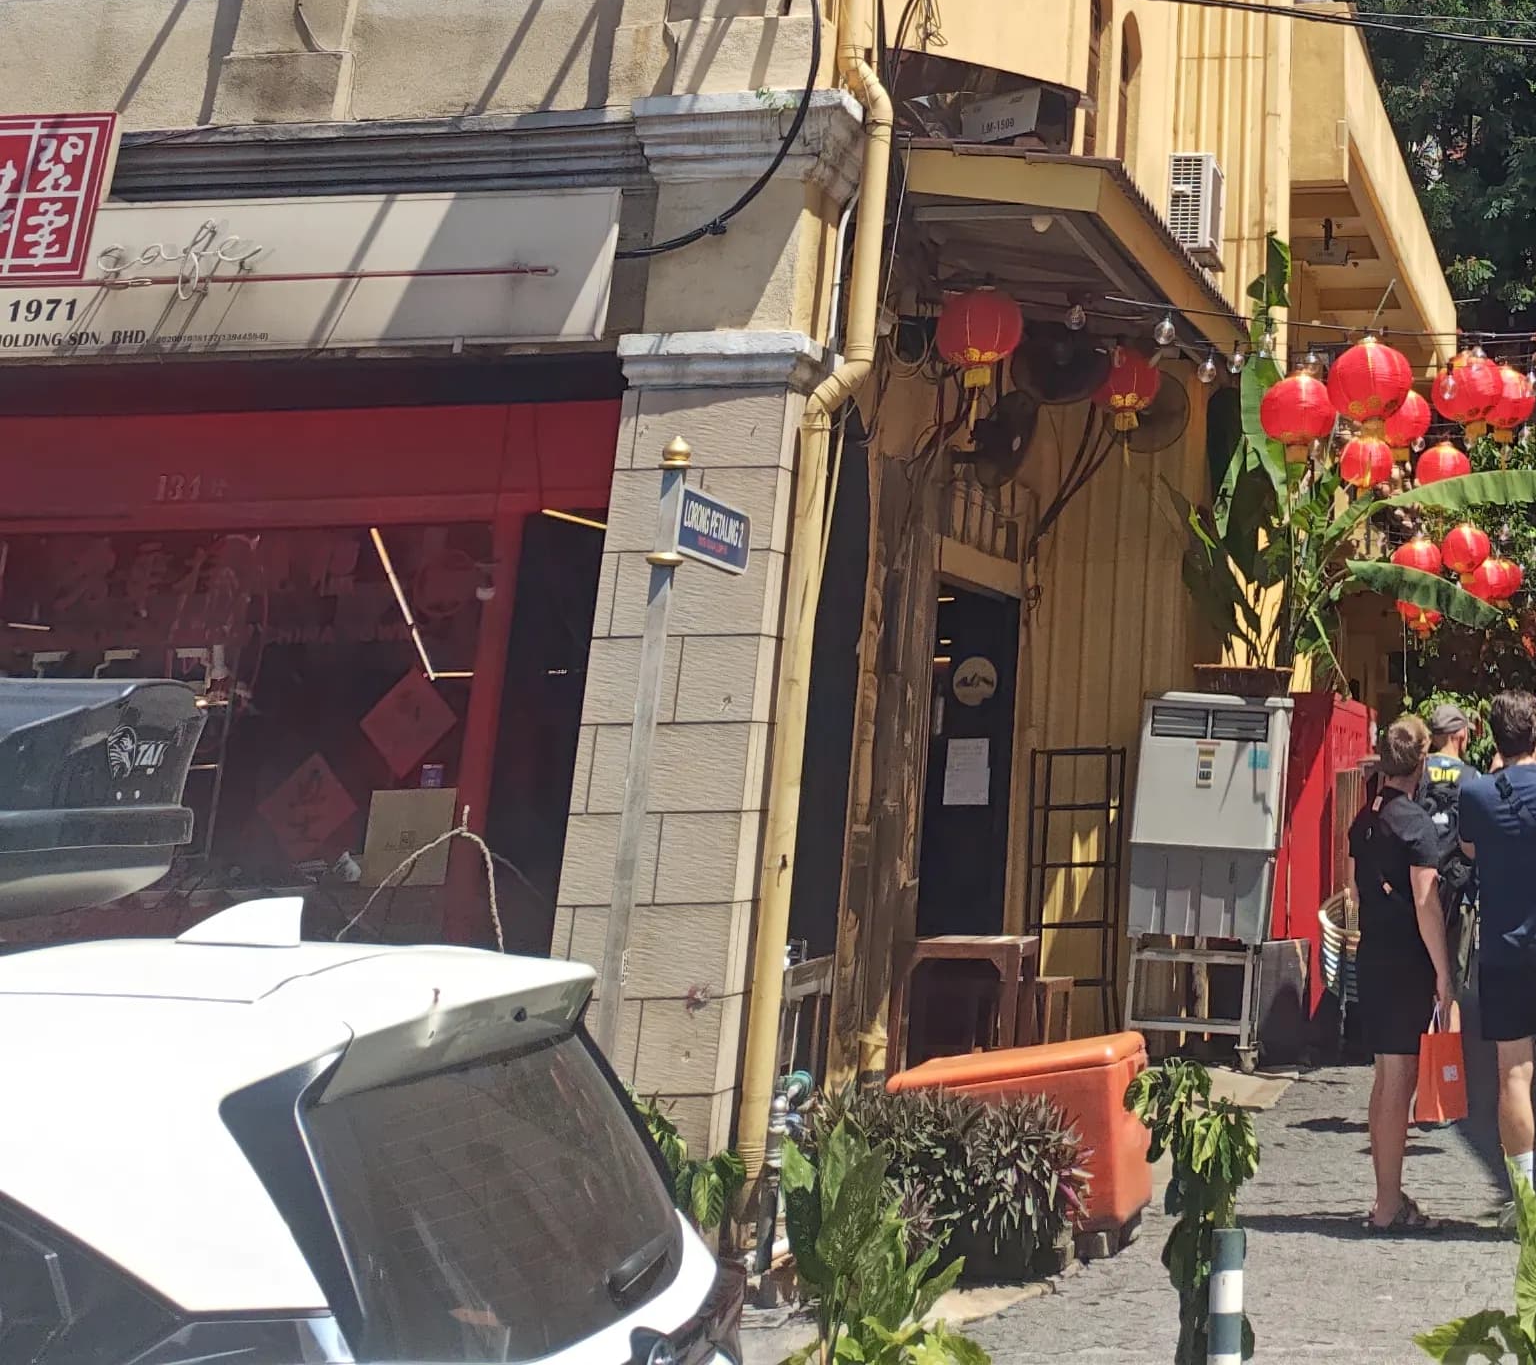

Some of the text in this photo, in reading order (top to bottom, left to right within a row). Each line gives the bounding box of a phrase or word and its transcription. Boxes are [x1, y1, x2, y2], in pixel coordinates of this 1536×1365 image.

[9, 298, 77, 322] 1971
[66, 330, 104, 346] SDN.
[111, 329, 149, 346] BHD.
[684, 499, 711, 536] LORONG
[709, 510, 739, 546] PETALING
[738, 522, 745, 548] 2
